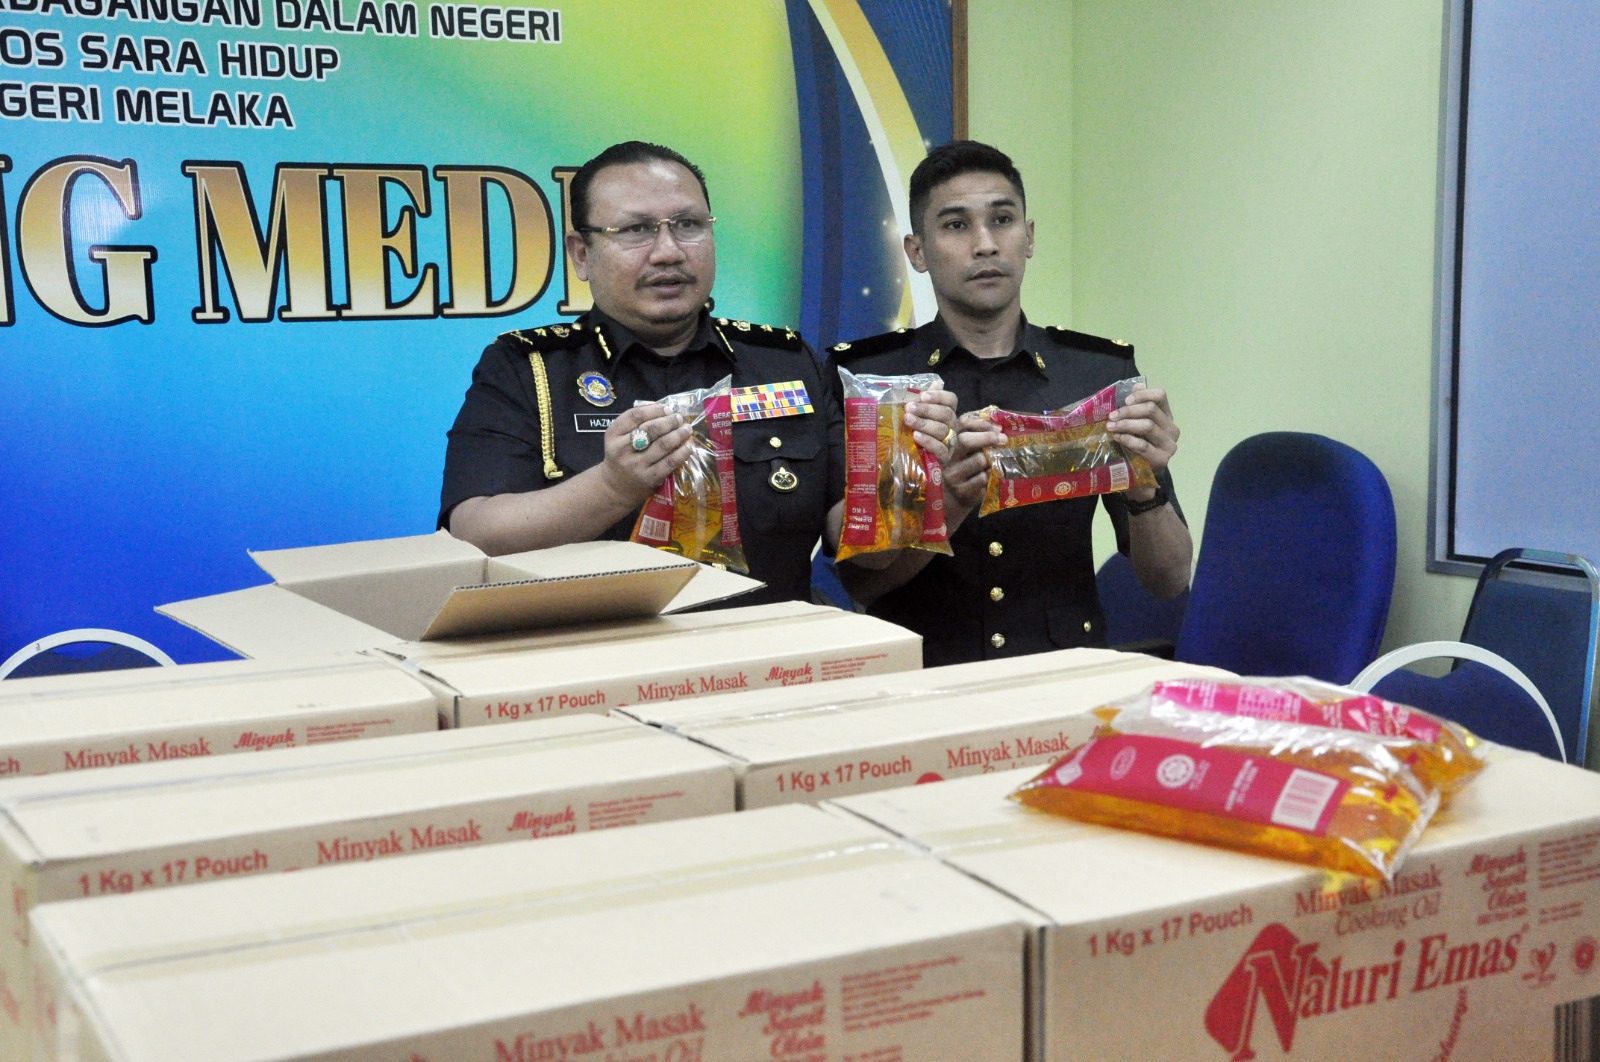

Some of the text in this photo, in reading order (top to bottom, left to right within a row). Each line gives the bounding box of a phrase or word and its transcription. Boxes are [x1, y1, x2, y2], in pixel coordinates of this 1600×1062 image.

[275, 0, 418, 36] DALAM
[430, 4, 561, 42] NEGERI
[80, 34, 207, 75] SARA
[219, 42, 339, 80] HIDUP
[115, 88, 294, 128] MELAKA
[0, 154, 158, 328] G
[637, 671, 749, 702] Minyak Masak
[764, 662, 813, 682] Minyak
[484, 690, 606, 719] 1 Kg x 17 Pouch
[64, 737, 213, 770] Minyak Masak
[233, 728, 296, 749] Minyak
[946, 731, 1070, 769] Minyak Masak
[777, 755, 912, 793] 1 Kg x 17 Pouch
[317, 819, 483, 865] Minyak Masak
[79, 849, 269, 897] 1 Kg x 17 Pouch
[1295, 864, 1443, 917] Minyak Masak
[1088, 903, 1253, 957] 1 Kg x 17 Pouch
[1220, 940, 1406, 1062] Naluri
[1411, 933, 1522, 993] Emas
[494, 1003, 706, 1062] Minyak Masak
